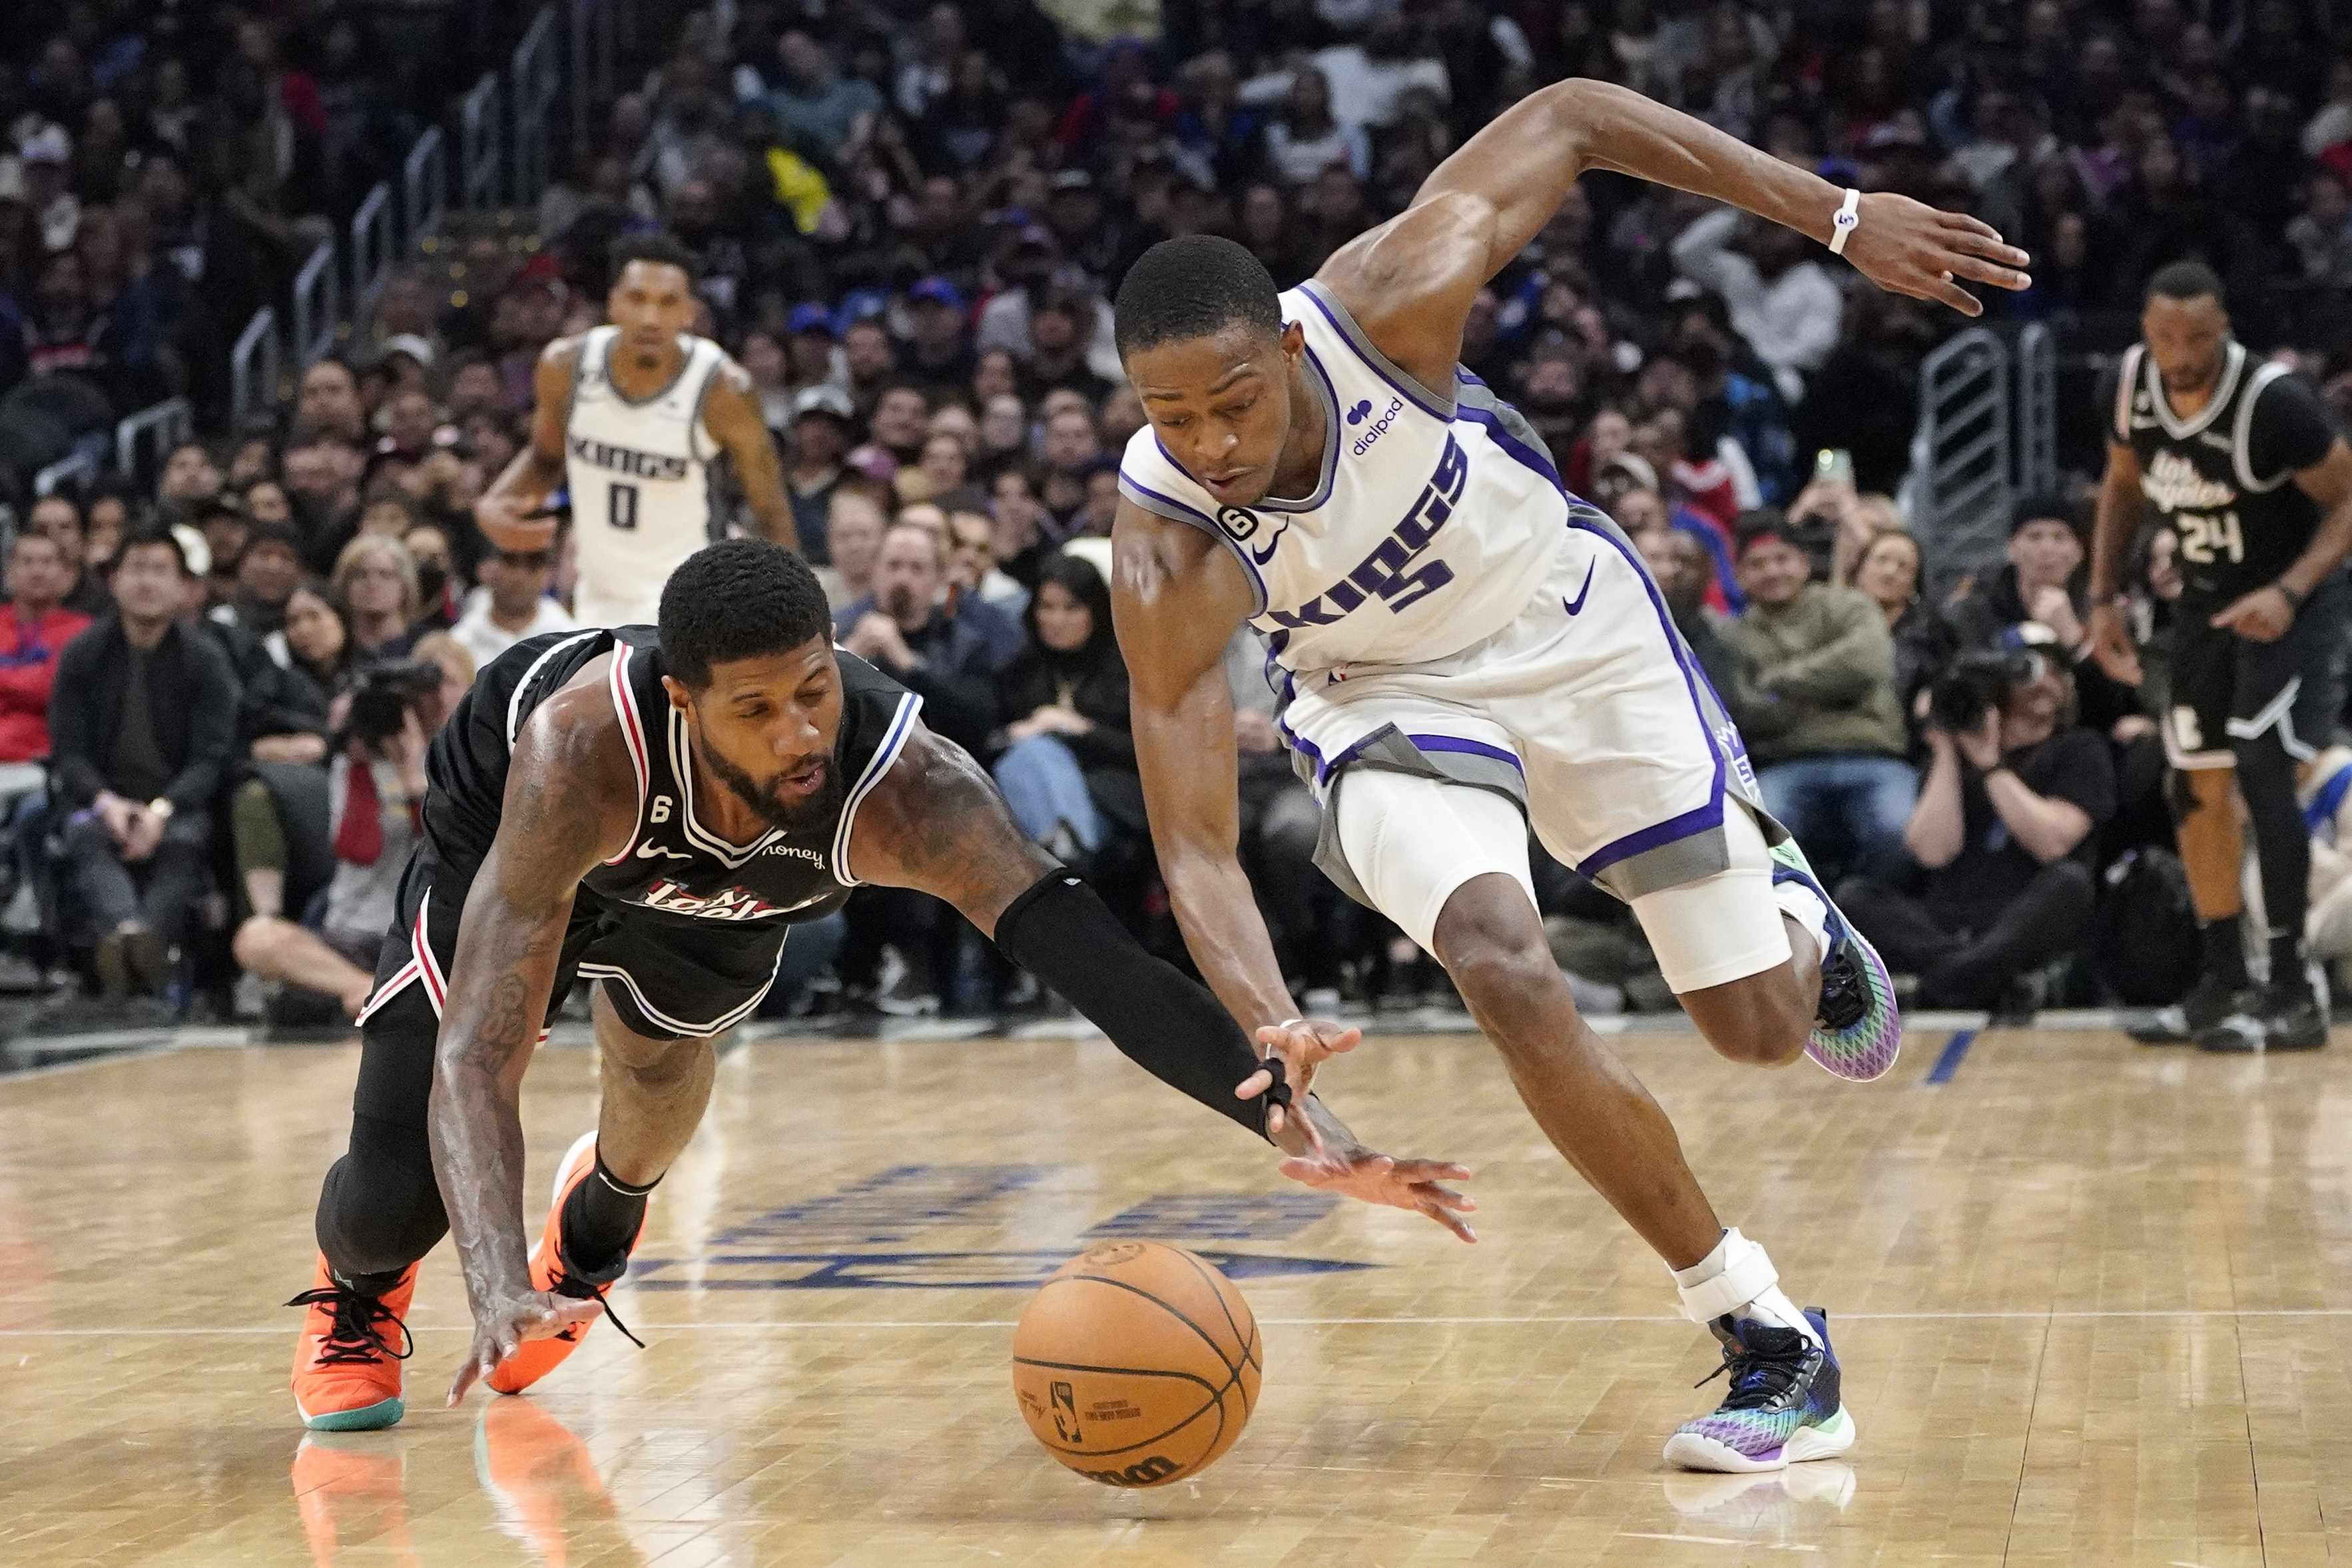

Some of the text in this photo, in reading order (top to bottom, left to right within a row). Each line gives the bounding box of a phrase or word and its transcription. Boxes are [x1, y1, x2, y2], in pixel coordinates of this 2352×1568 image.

[1353, 396, 1404, 456] dialpad
[571, 438, 687, 479] KINGS
[609, 483, 637, 529] 0
[1221, 508, 1254, 537] 6
[1267, 429, 1468, 630] KINGS
[2176, 511, 2244, 564] 24
[1374, 540, 1456, 615] 5
[650, 794, 673, 824] 6
